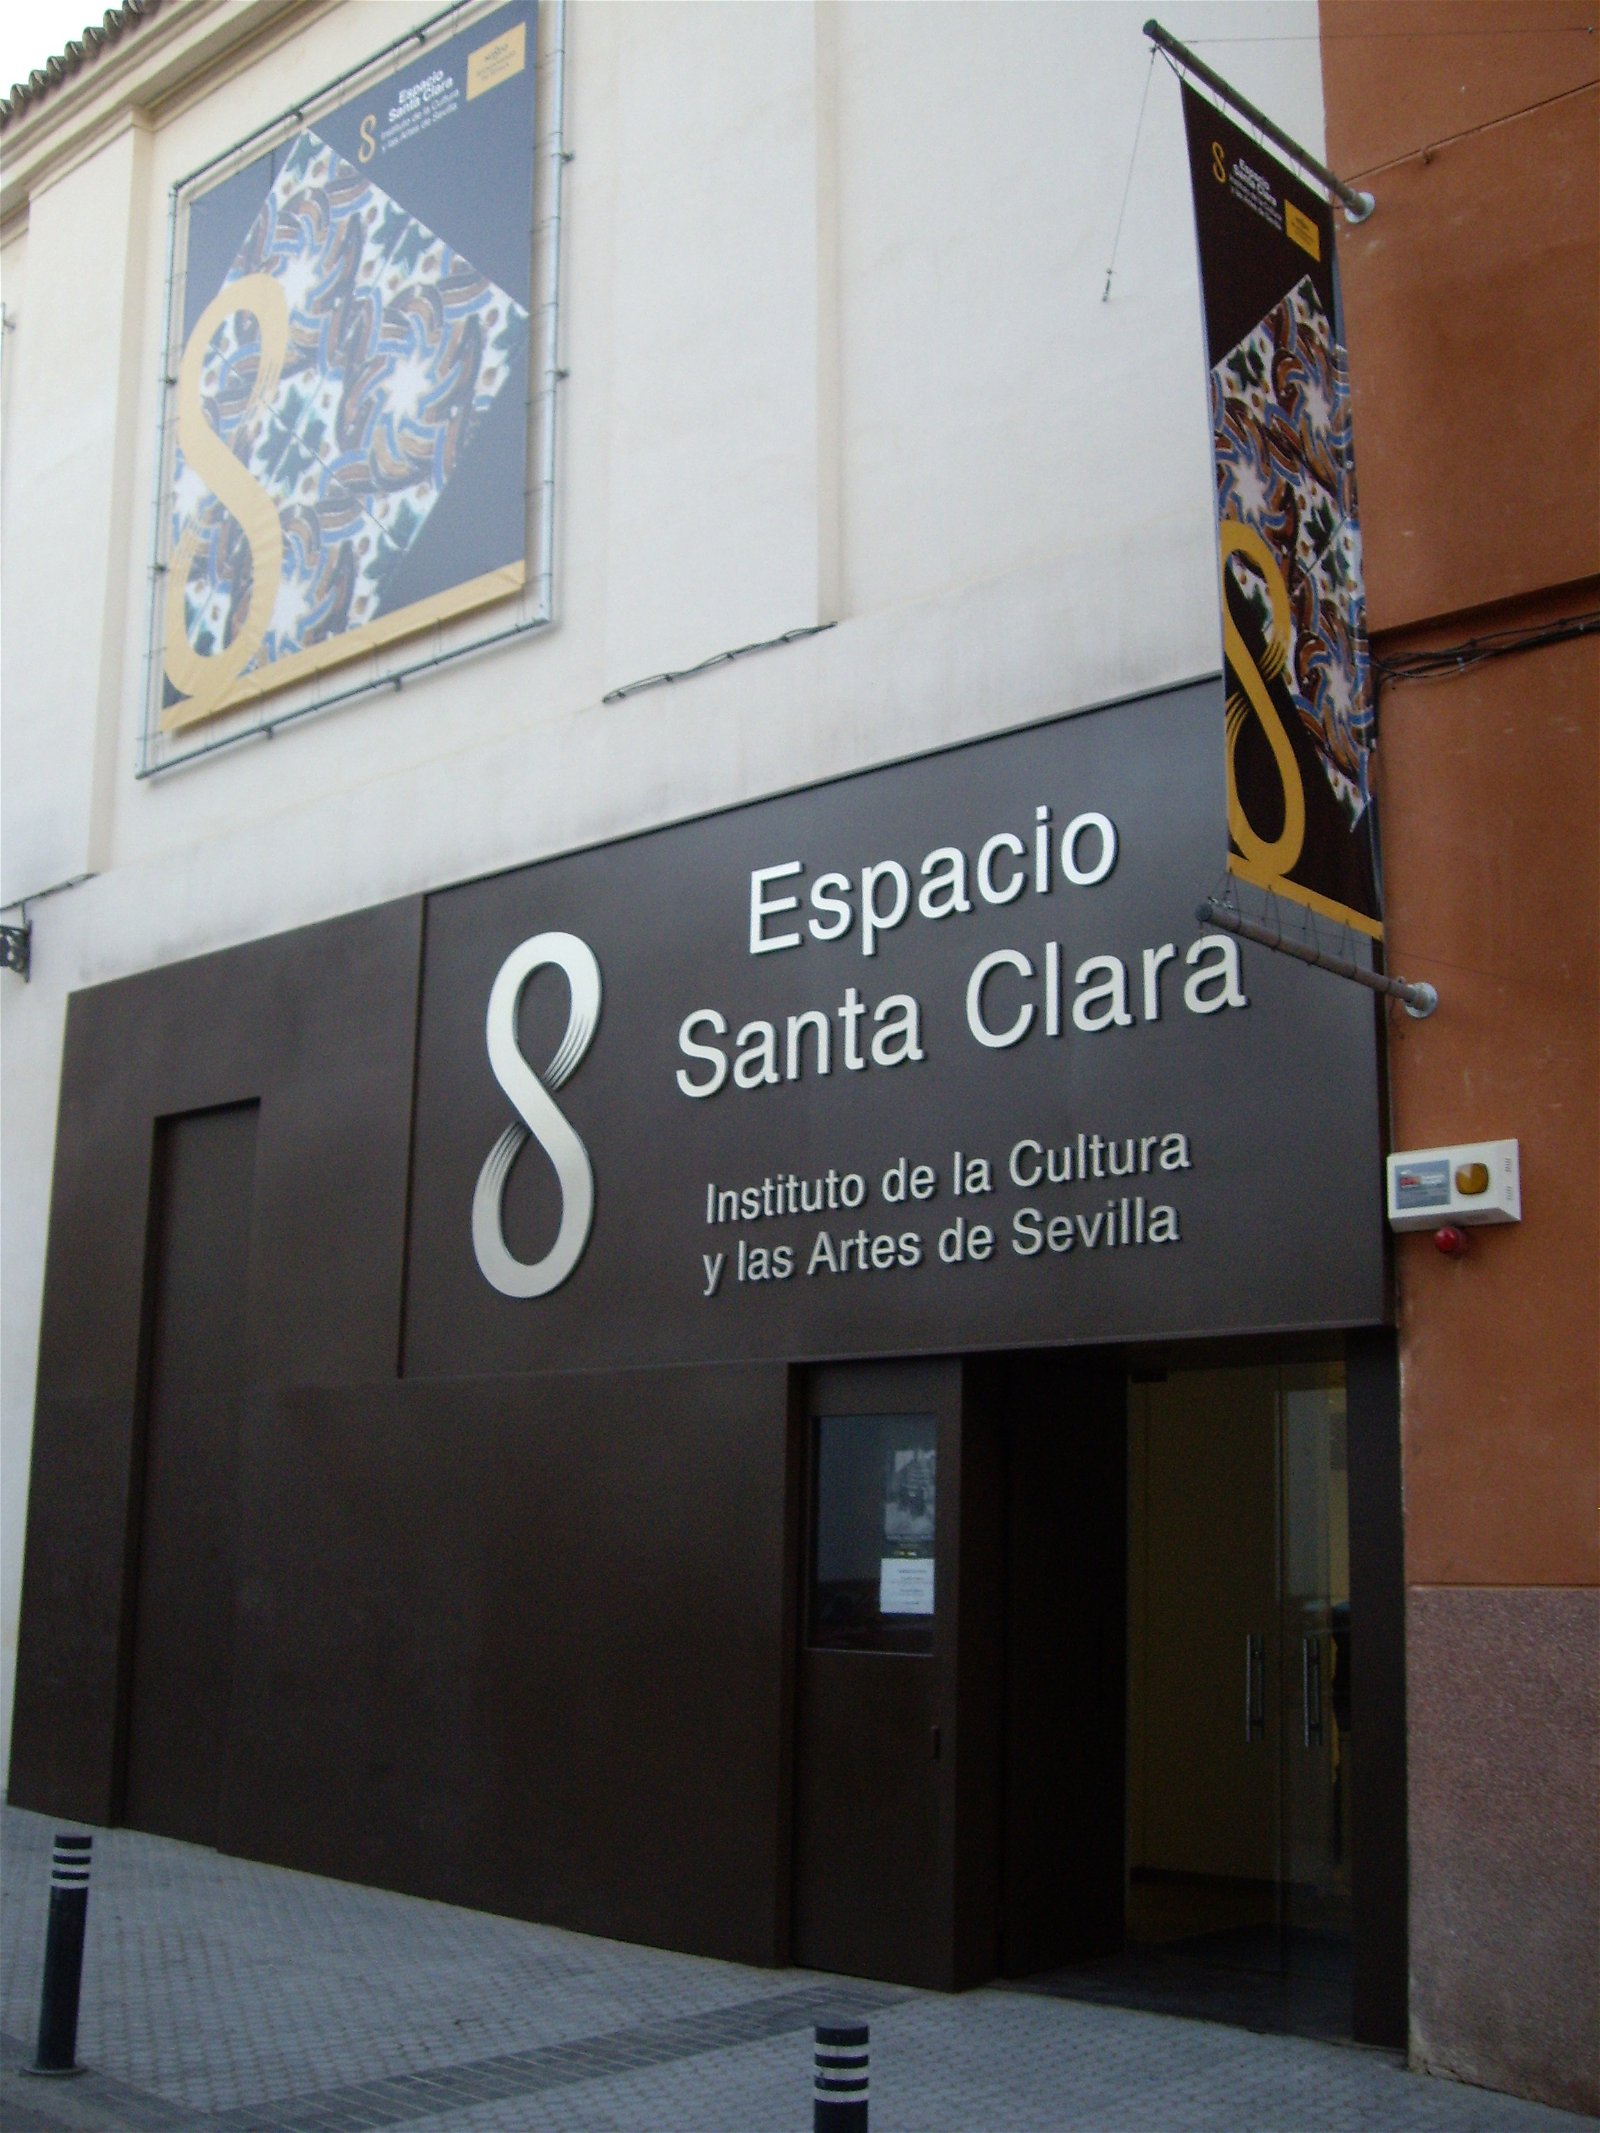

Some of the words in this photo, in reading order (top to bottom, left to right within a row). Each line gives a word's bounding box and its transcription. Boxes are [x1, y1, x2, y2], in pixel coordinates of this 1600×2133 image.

[748, 804, 1118, 956] Espacio
[674, 987, 925, 1099] Santa
[964, 932, 1249, 1049] Clara
[705, 1168, 865, 1224] Instituto
[881, 1156, 935, 1203] de
[952, 1150, 992, 1196] la
[1008, 1131, 1191, 1188] Cultura
[702, 1252, 724, 1296] y
[736, 1240, 795, 1282] las
[806, 1228, 922, 1277] Artes
[937, 1217, 994, 1264] de
[1011, 1197, 1181, 1256] Sevilla
